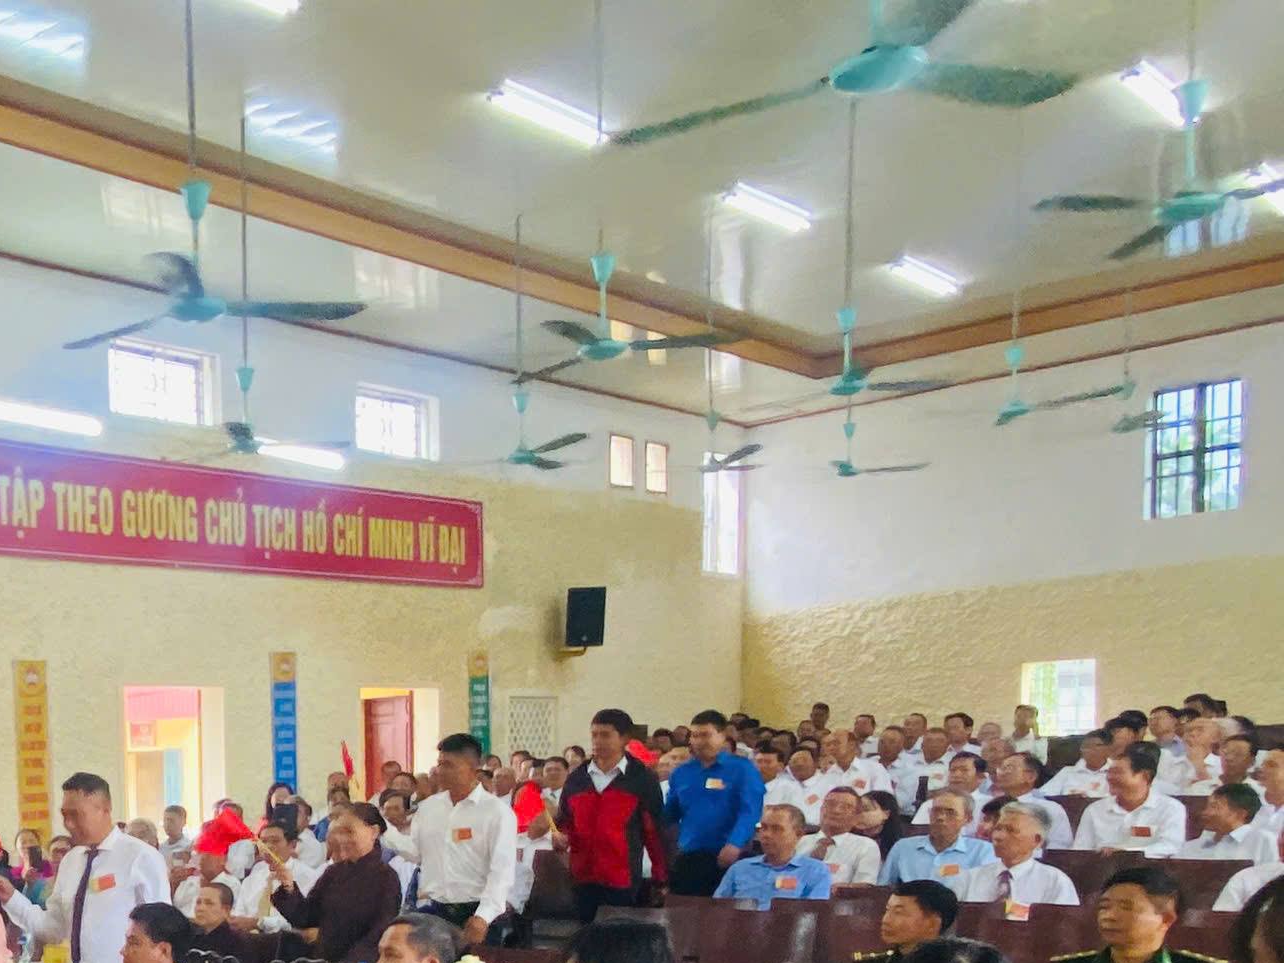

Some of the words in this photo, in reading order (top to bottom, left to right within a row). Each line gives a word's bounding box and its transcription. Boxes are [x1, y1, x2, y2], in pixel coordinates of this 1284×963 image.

[51, 480, 114, 536] THEO
[120, 488, 199, 544] GƯƠNG
[204, 487, 247, 547] CHỦ
[251, 504, 297, 560] TỊCH
[332, 506, 364, 558] CHÍ
[368, 516, 414, 561] MINH
